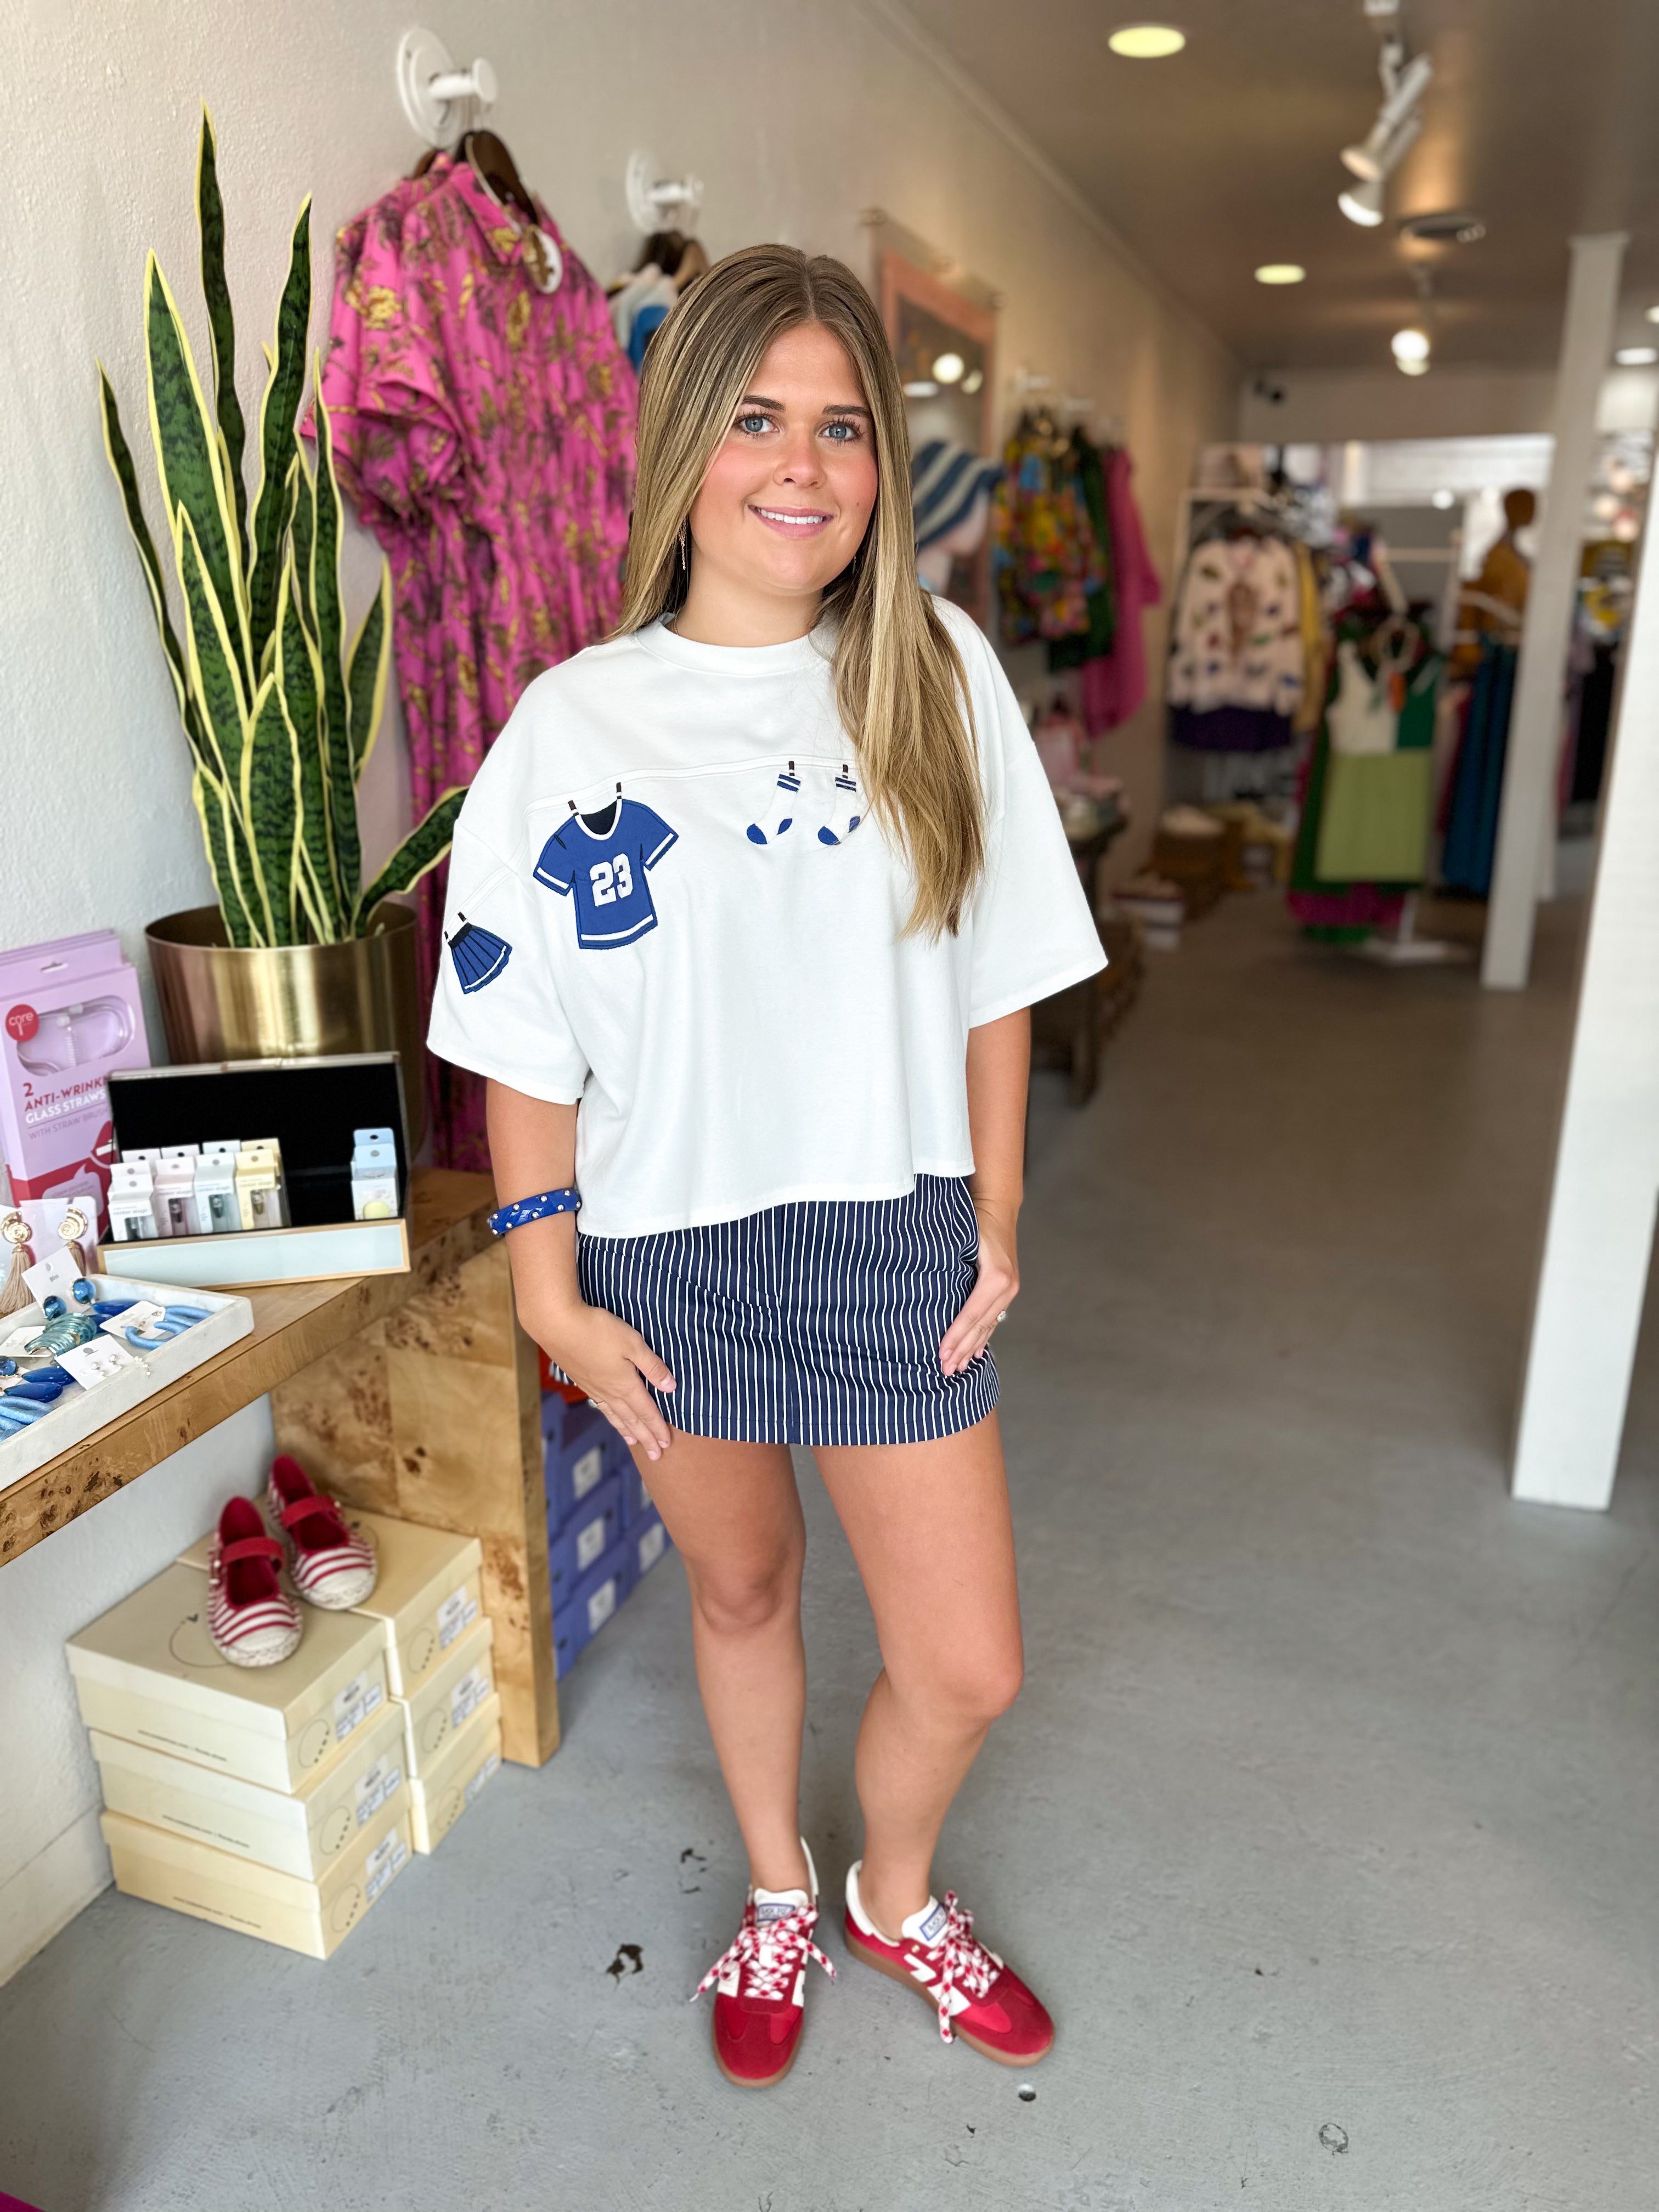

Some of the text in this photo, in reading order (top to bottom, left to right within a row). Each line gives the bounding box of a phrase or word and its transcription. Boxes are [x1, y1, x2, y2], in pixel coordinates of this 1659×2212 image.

[589, 853, 633, 907] 23
[23, 1082, 34, 1097] 2
[26, 1089, 106, 1124] GLASS STRAWS
[29, 1108, 108, 1139] WITH STRAW BRUSH
